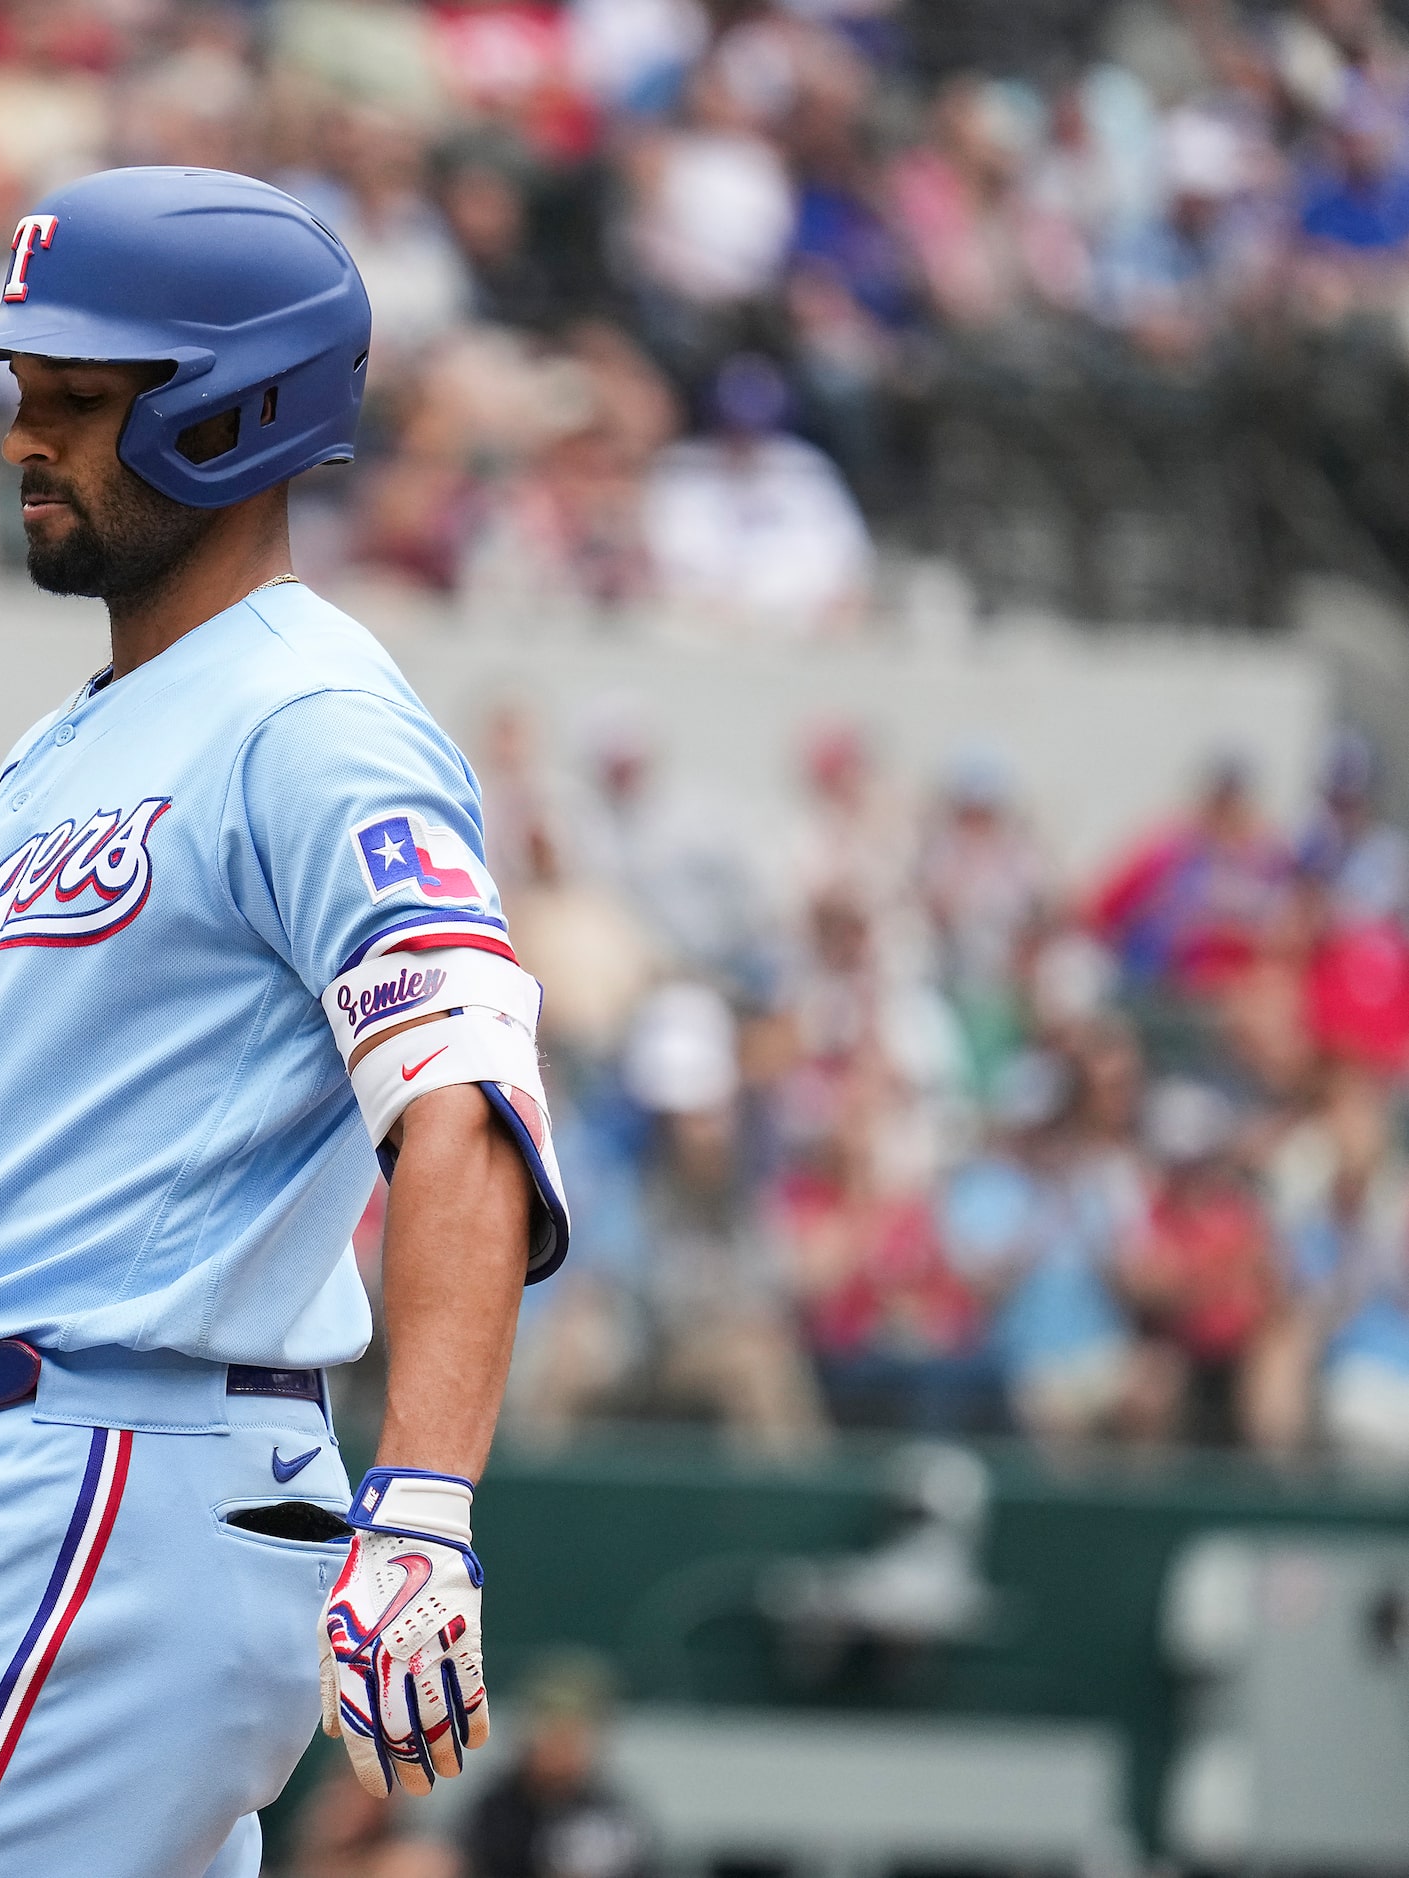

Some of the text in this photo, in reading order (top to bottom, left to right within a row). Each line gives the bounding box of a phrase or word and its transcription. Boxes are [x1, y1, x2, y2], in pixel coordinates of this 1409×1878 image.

[3, 214, 59, 303] T
[337, 968, 447, 1039] Semien
[362, 1485, 380, 1513] NIKE
